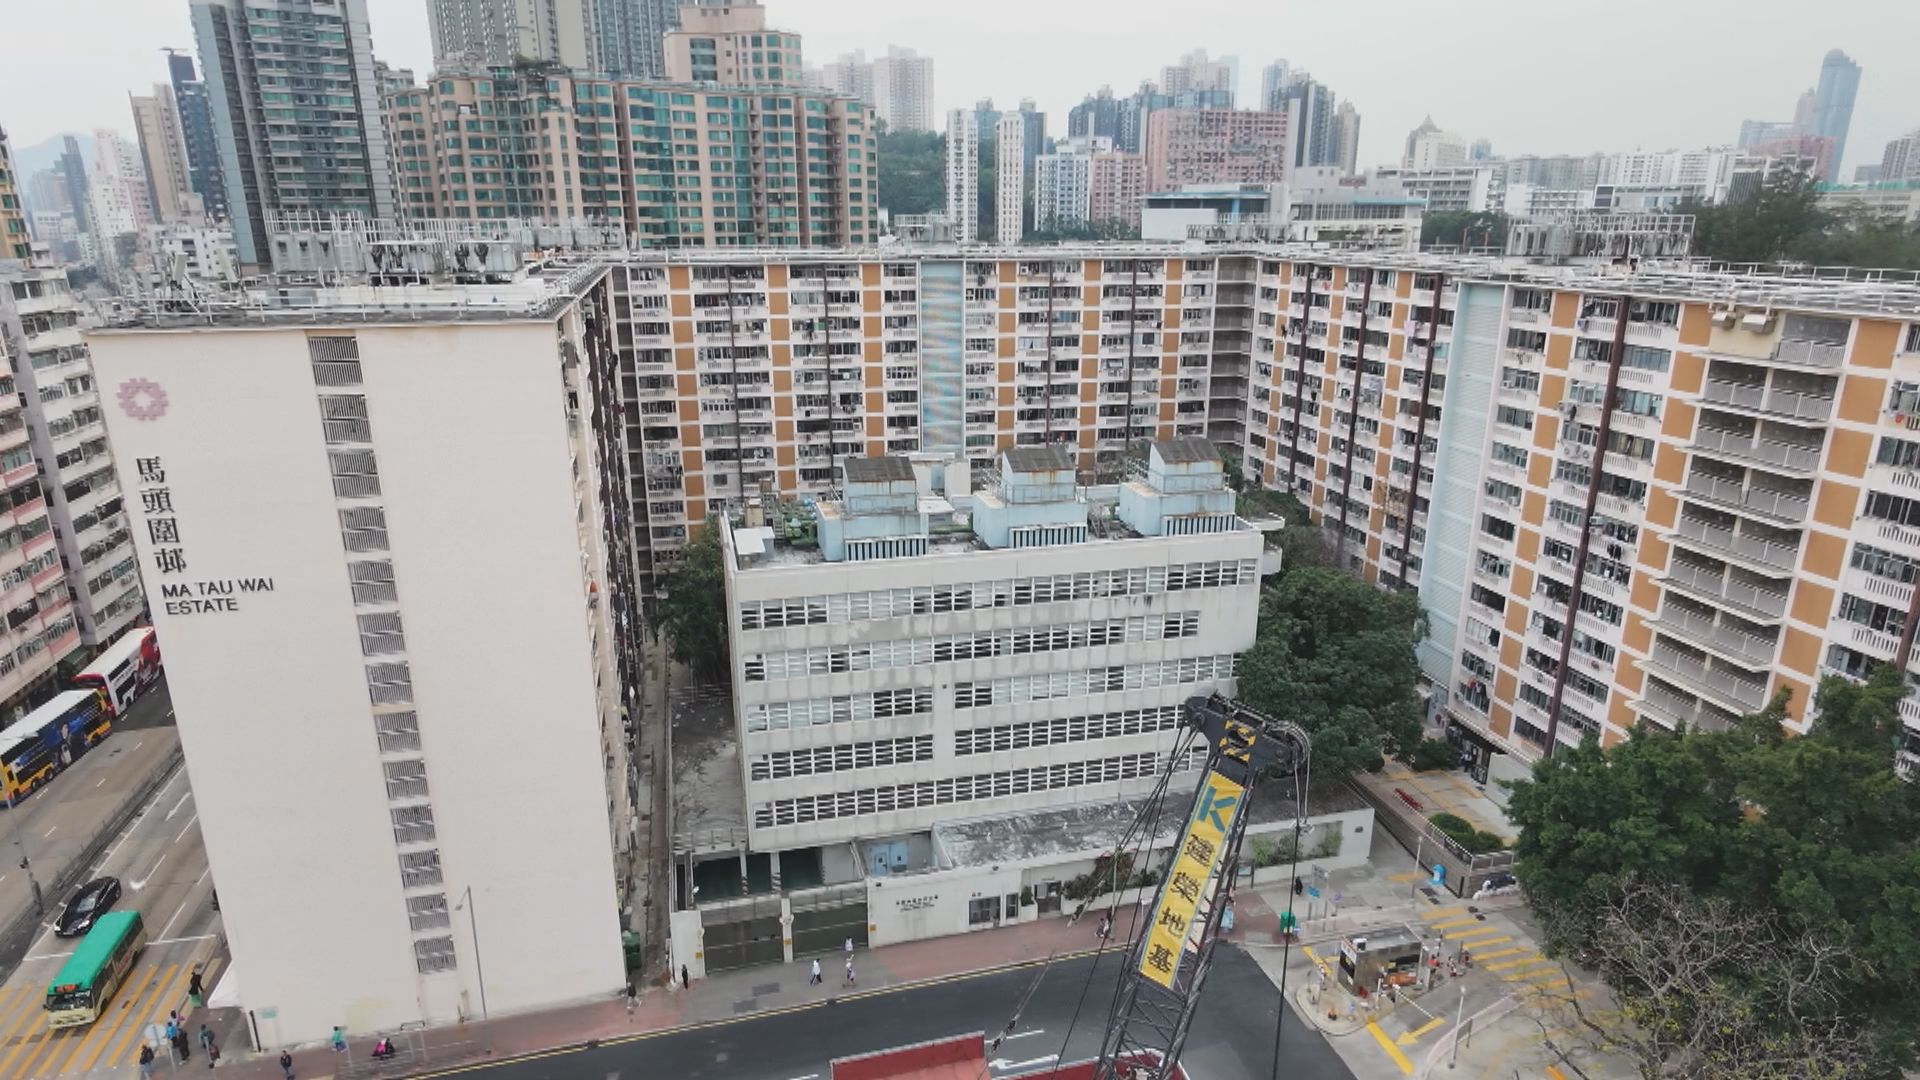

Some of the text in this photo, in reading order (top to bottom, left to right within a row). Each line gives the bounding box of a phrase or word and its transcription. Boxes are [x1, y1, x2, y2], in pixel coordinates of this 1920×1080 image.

[136, 456, 187, 574] 馬頭圍邨
[161, 577, 274, 599] MA TAU WAI
[165, 598, 239, 615] ESTATE
[1147, 834, 1215, 974] 建榮地基
